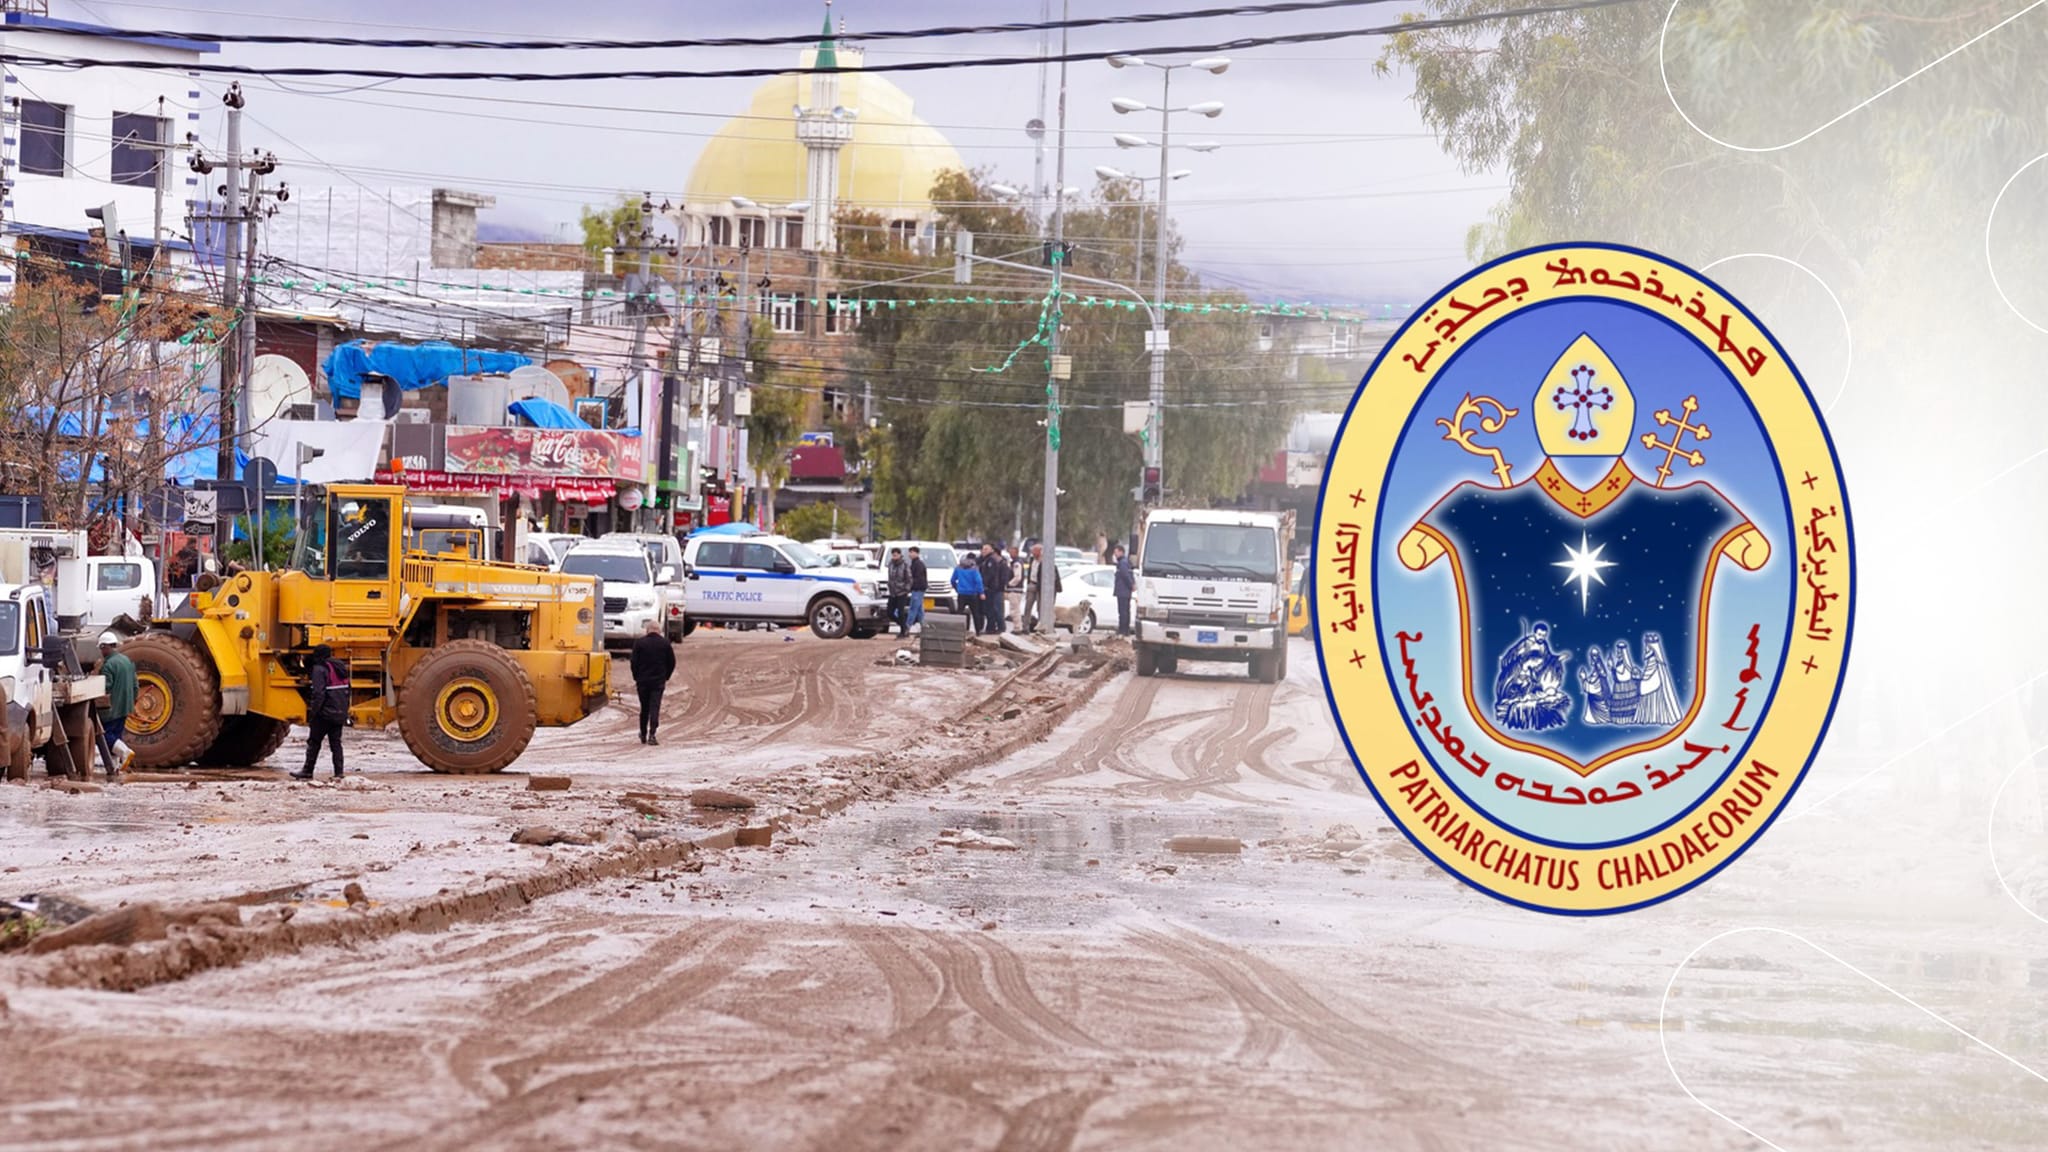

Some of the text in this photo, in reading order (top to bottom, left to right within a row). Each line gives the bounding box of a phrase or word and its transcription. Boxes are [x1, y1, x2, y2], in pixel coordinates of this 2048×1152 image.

[347, 519, 377, 542] VOLVO
[702, 590, 763, 602] TRAFFIC POLICE
